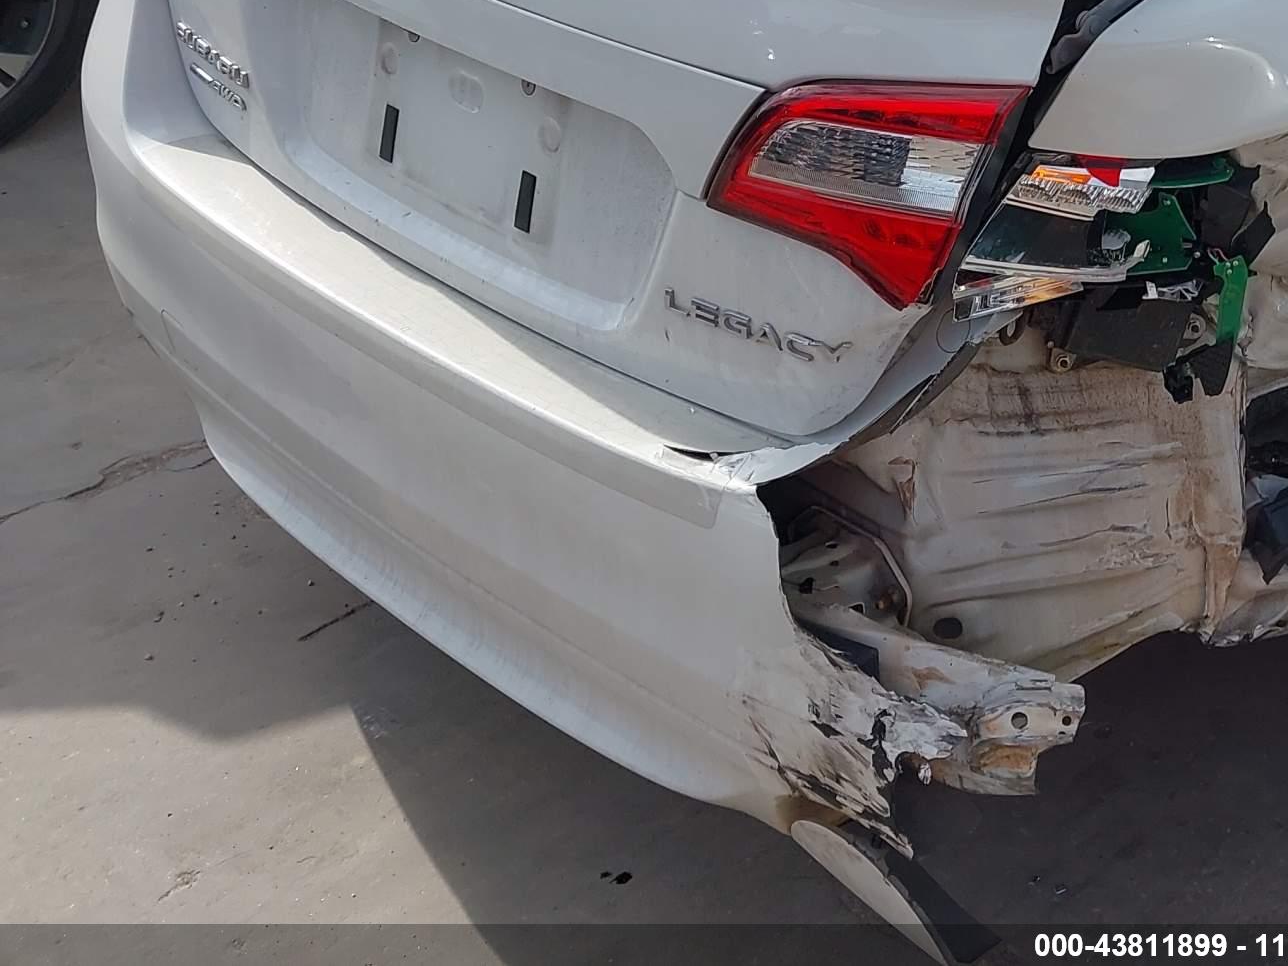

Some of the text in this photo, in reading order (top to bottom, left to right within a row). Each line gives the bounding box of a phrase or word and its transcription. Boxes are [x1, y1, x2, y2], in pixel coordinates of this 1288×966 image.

[176, 20, 250, 88] SUBARU
[209, 80, 247, 111] AWD
[664, 287, 853, 362] LEGACY
